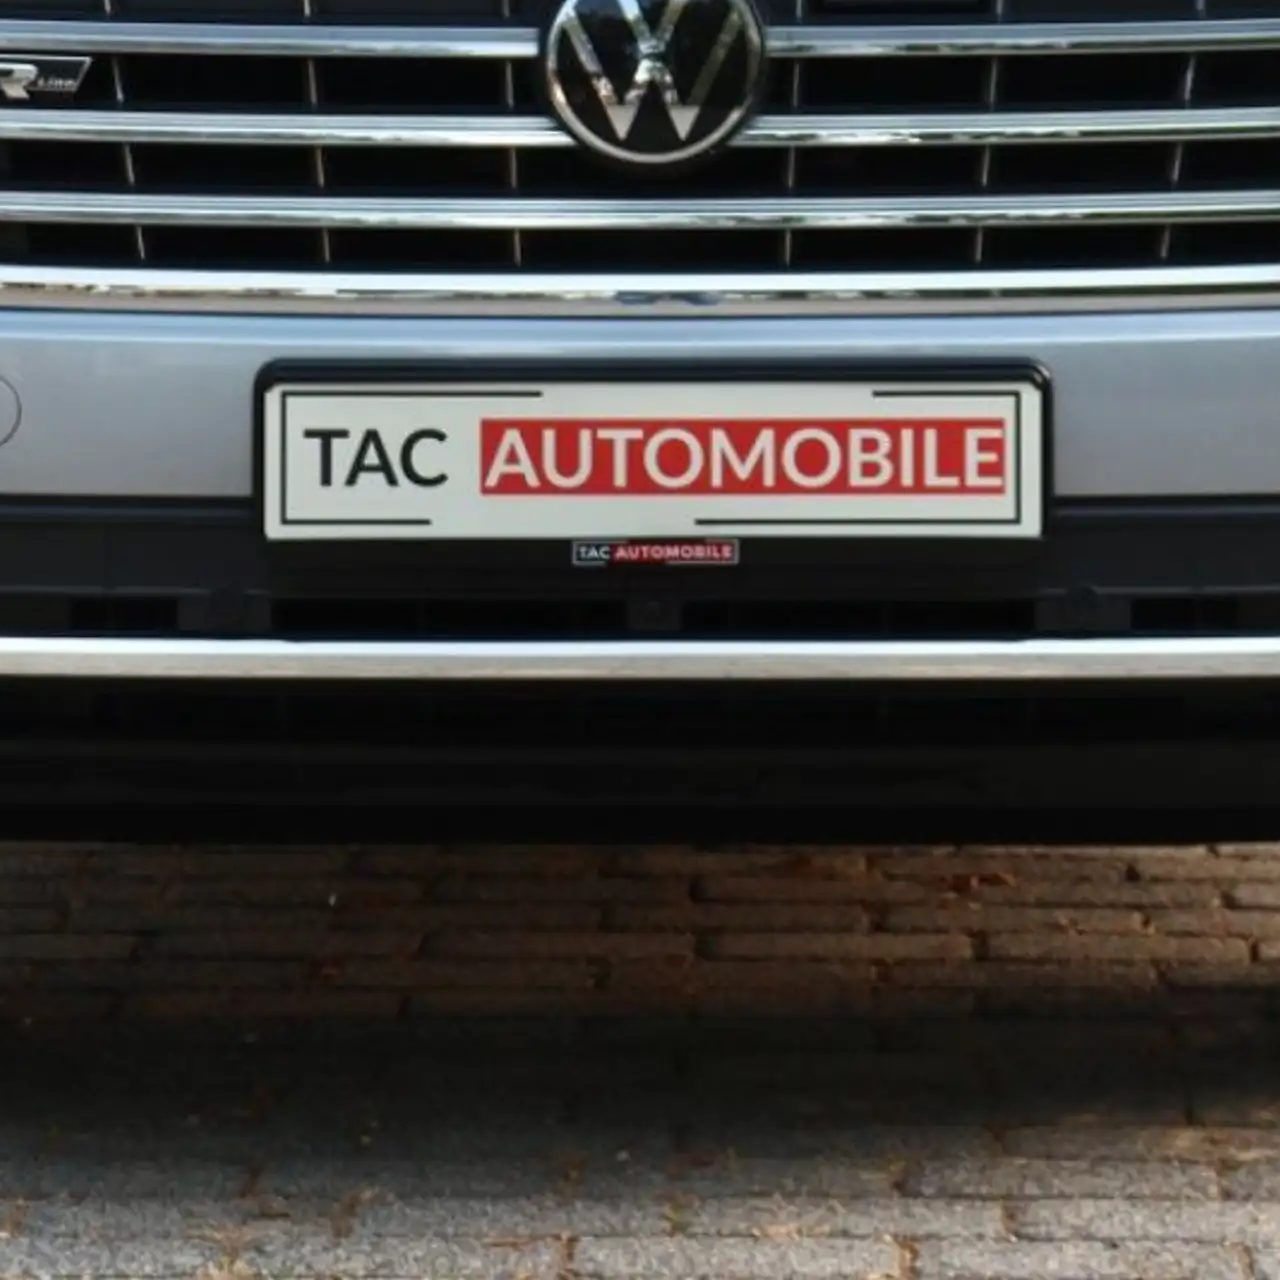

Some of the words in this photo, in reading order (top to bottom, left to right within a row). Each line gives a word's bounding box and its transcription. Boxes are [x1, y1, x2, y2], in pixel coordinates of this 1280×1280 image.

[303, 428, 449, 488] TAC
[484, 427, 1004, 489] AUTOMOBILE
[579, 545, 610, 560] TAC
[614, 543, 733, 561] AUTOMOBILE
